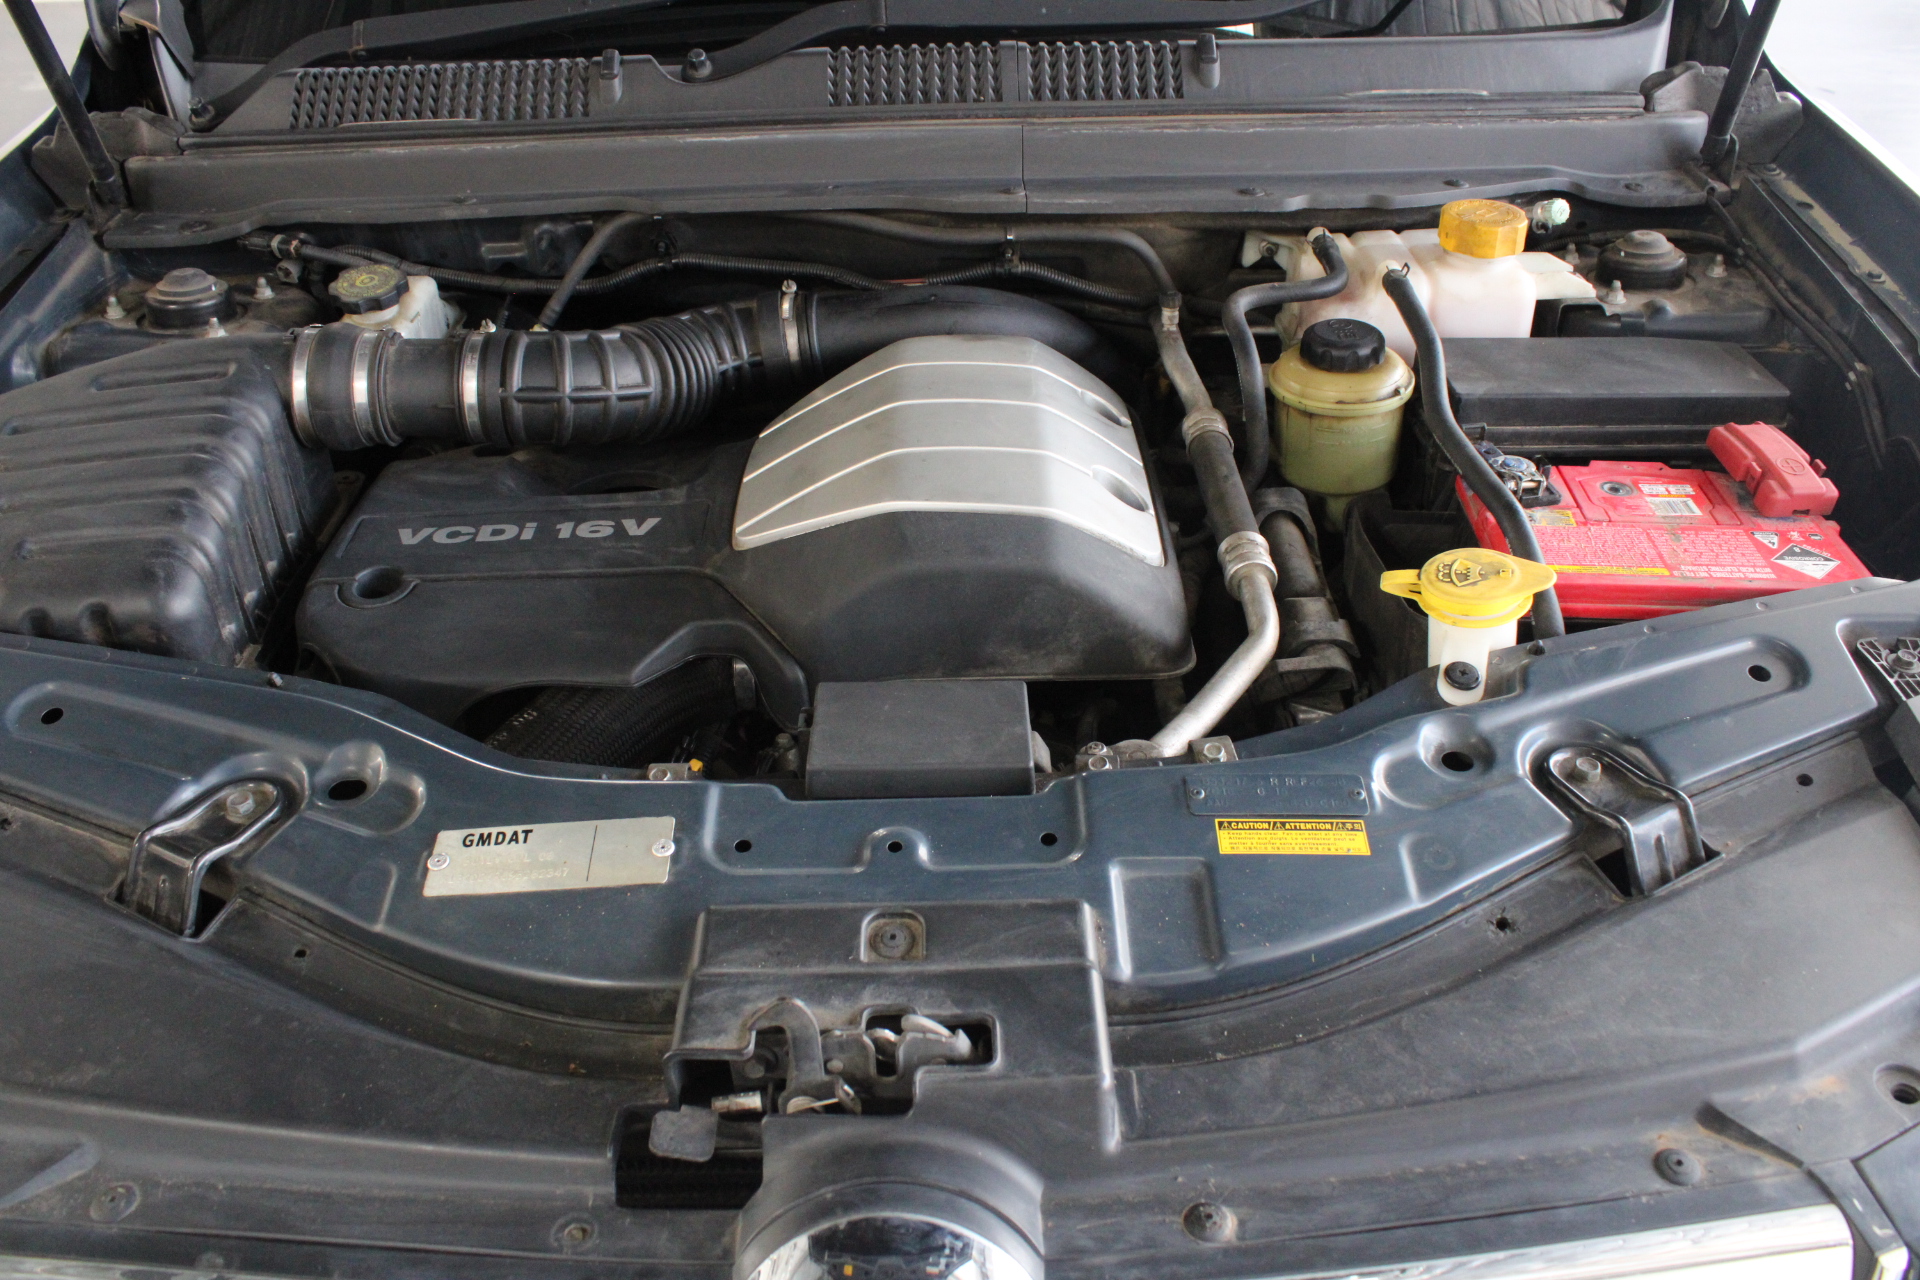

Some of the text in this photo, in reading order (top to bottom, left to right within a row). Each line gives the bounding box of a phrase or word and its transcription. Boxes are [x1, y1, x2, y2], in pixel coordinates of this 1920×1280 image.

[398, 517, 662, 545] VCDi 16V
[462, 829, 533, 848] GMDAT
